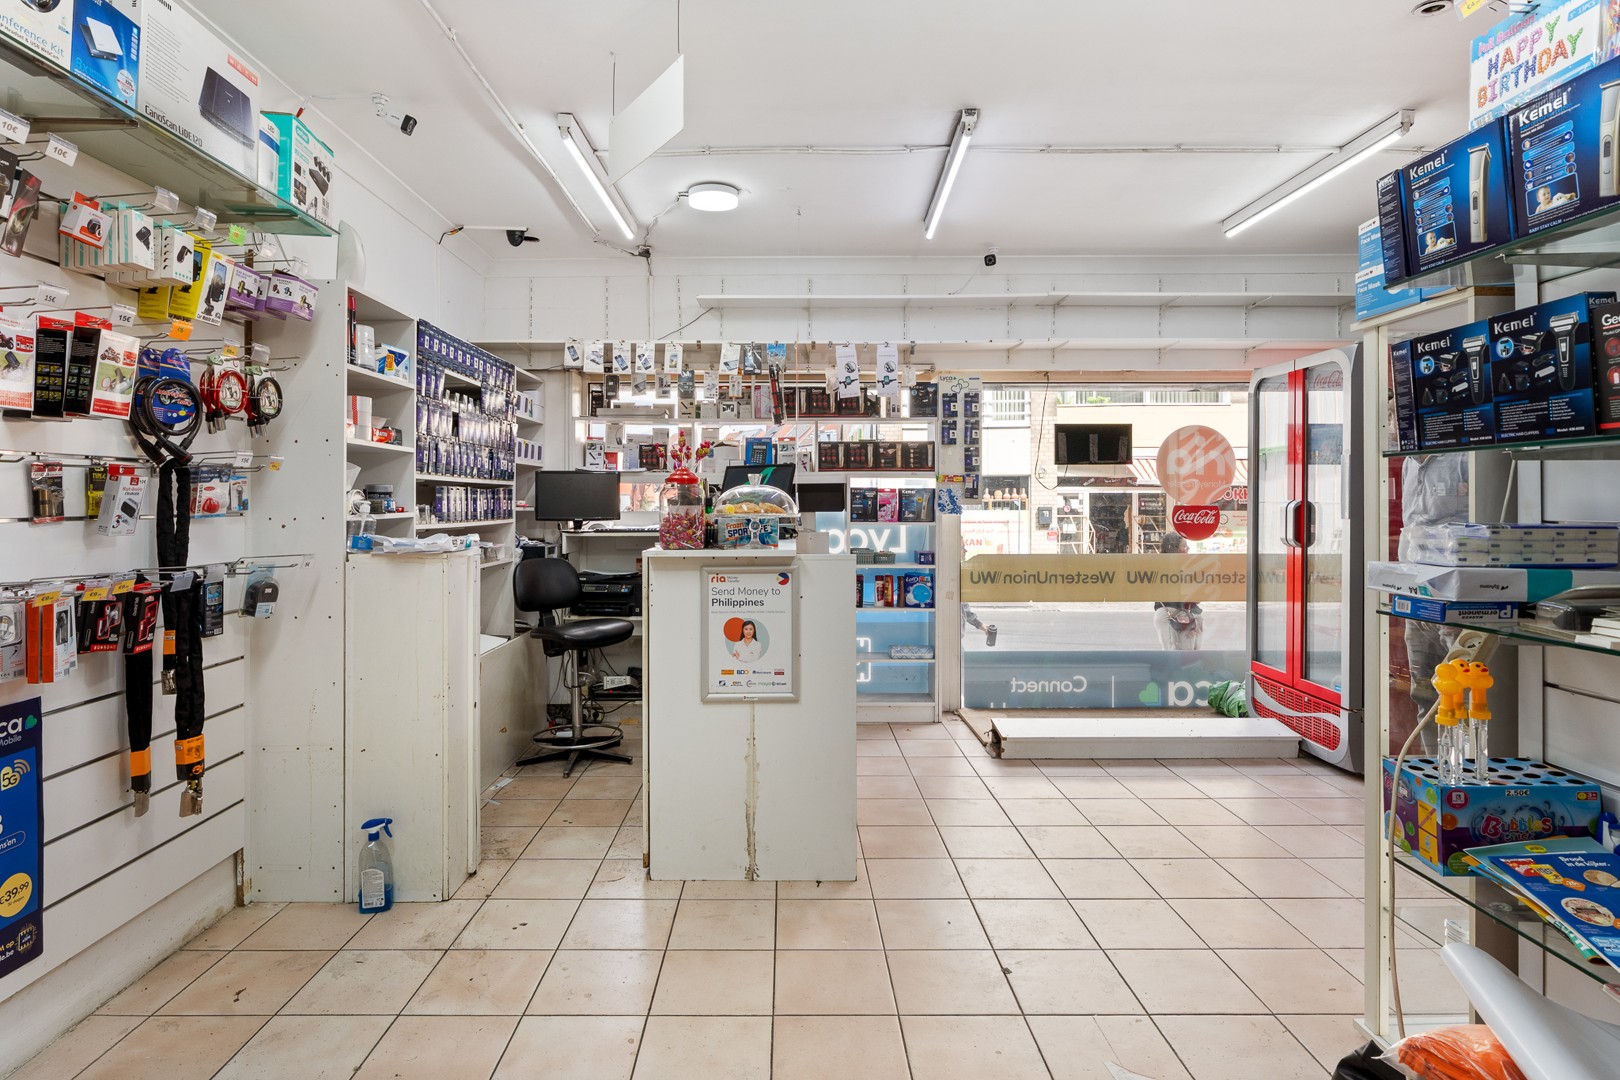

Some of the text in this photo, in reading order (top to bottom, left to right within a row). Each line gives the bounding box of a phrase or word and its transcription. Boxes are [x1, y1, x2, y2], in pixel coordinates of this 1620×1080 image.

[51, 42, 64, 56] Kit
[1488, 15, 1560, 80] HAPPY
[1478, 27, 1584, 108] BIRTHDAY
[1519, 91, 1568, 128] Kemei
[2, 121, 18, 134] 10€
[144, 104, 203, 147] CanoScan LiDE 120
[267, 123, 276, 134] LED
[52, 146, 68, 158] 10€
[1410, 153, 1446, 180] Kemei
[1358, 282, 1380, 294] Face Mask
[44, 294, 56, 302] 15€
[118, 314, 132, 322] 15€
[1494, 314, 1534, 335] Kemei
[1417, 336, 1450, 353] Kemei
[1173, 508, 1218, 524] Coca-Cola
[711, 573, 726, 583] ria
[711, 587, 735, 596] Send
[738, 587, 769, 597] Money
[1408, 586, 1418, 595] A4
[711, 598, 764, 608] Philippines
[2, 772, 18, 788] 5G
[1481, 814, 1552, 838] Bubbles
[6, 940, 15, 949] op
